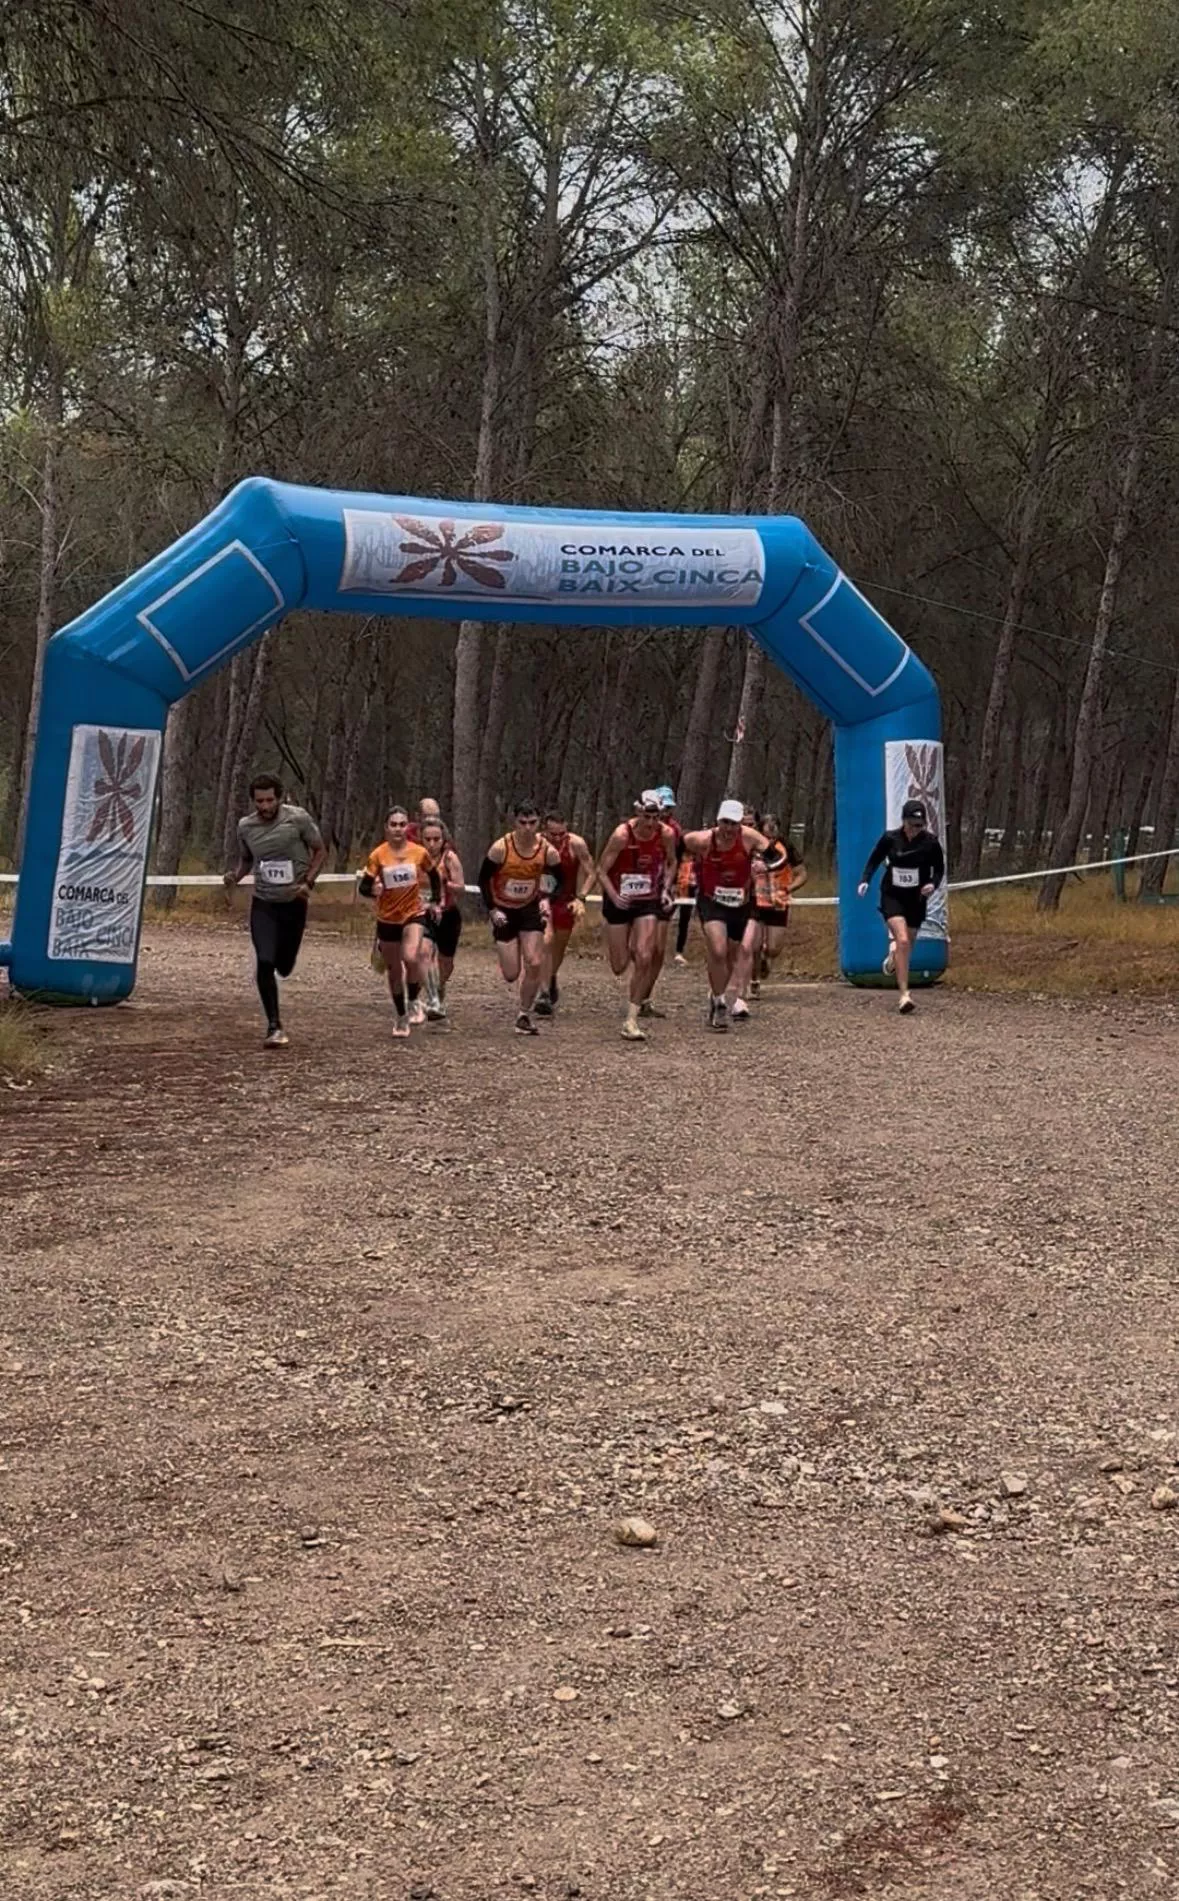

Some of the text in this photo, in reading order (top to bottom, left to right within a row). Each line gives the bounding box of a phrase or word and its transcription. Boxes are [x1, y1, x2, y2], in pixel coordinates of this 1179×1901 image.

[560, 544, 726, 557] COMARCA DEL
[561, 559, 644, 577] BAJO
[653, 570, 764, 585] CINCA
[558, 579, 641, 593] BAIX
[58, 884, 115, 903] COMARCA
